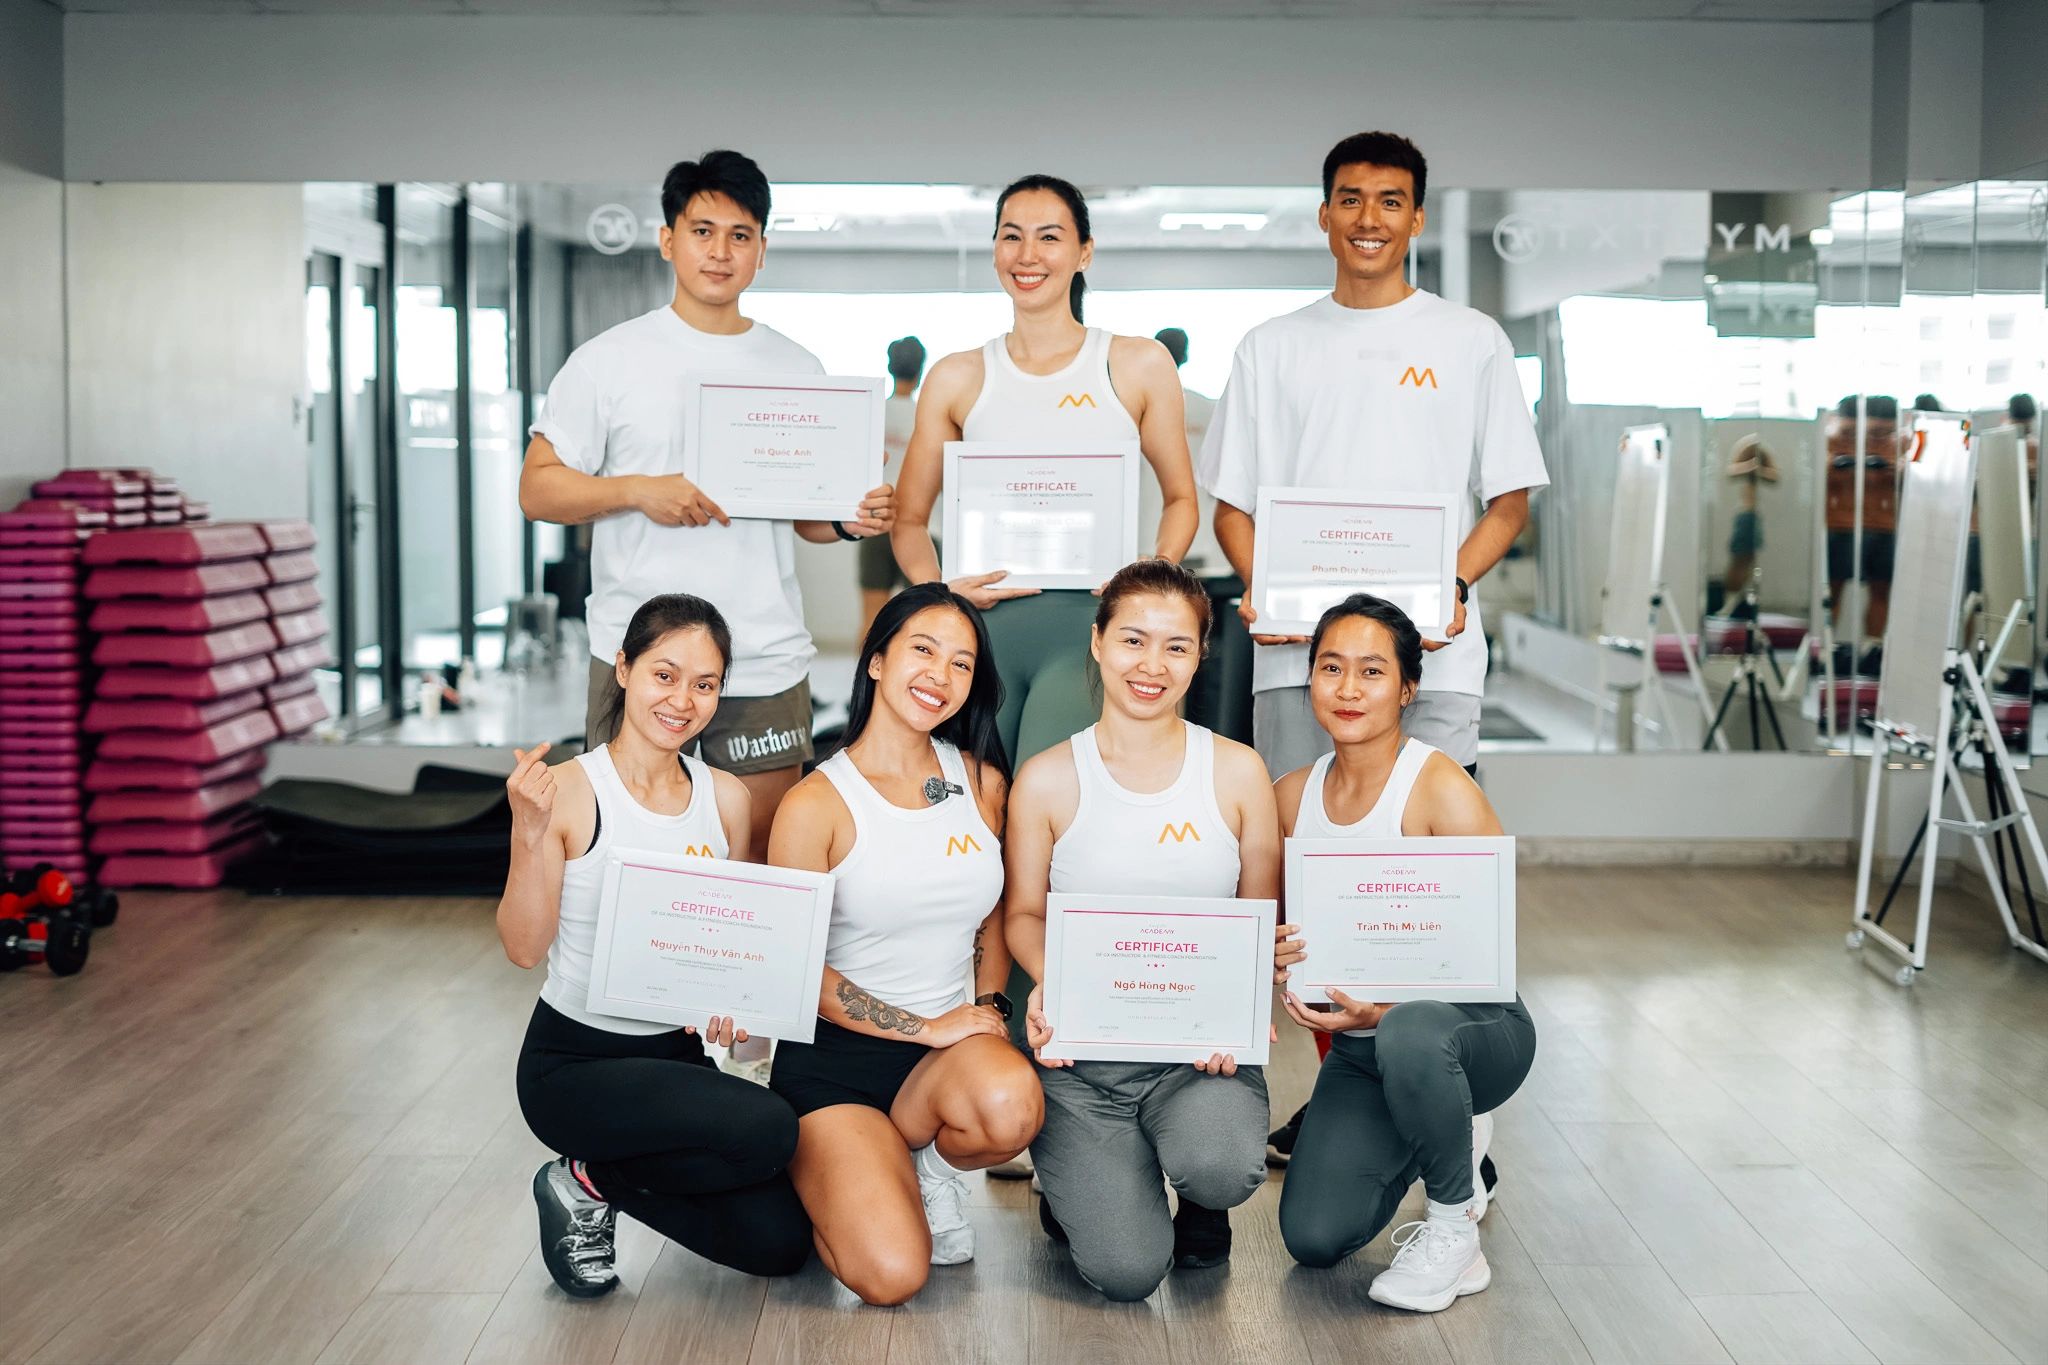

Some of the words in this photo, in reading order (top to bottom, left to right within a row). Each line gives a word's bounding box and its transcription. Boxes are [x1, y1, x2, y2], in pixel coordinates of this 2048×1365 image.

[1714, 222, 1792, 253] YM
[747, 412, 820, 424] CERTIFICATE
[794, 448, 812, 457] Anh
[1006, 482, 1077, 491] CERTIFICATE
[1319, 529, 1394, 541] CERTIFICATE
[1357, 882, 1441, 893] CERTIFICATE
[671, 901, 756, 922] CERTIFICATE
[1420, 920, 1442, 931] Liên
[1139, 928, 1176, 936] ACADEMY
[1114, 941, 1199, 953] CERTIFICATE
[743, 951, 765, 963] Anh
